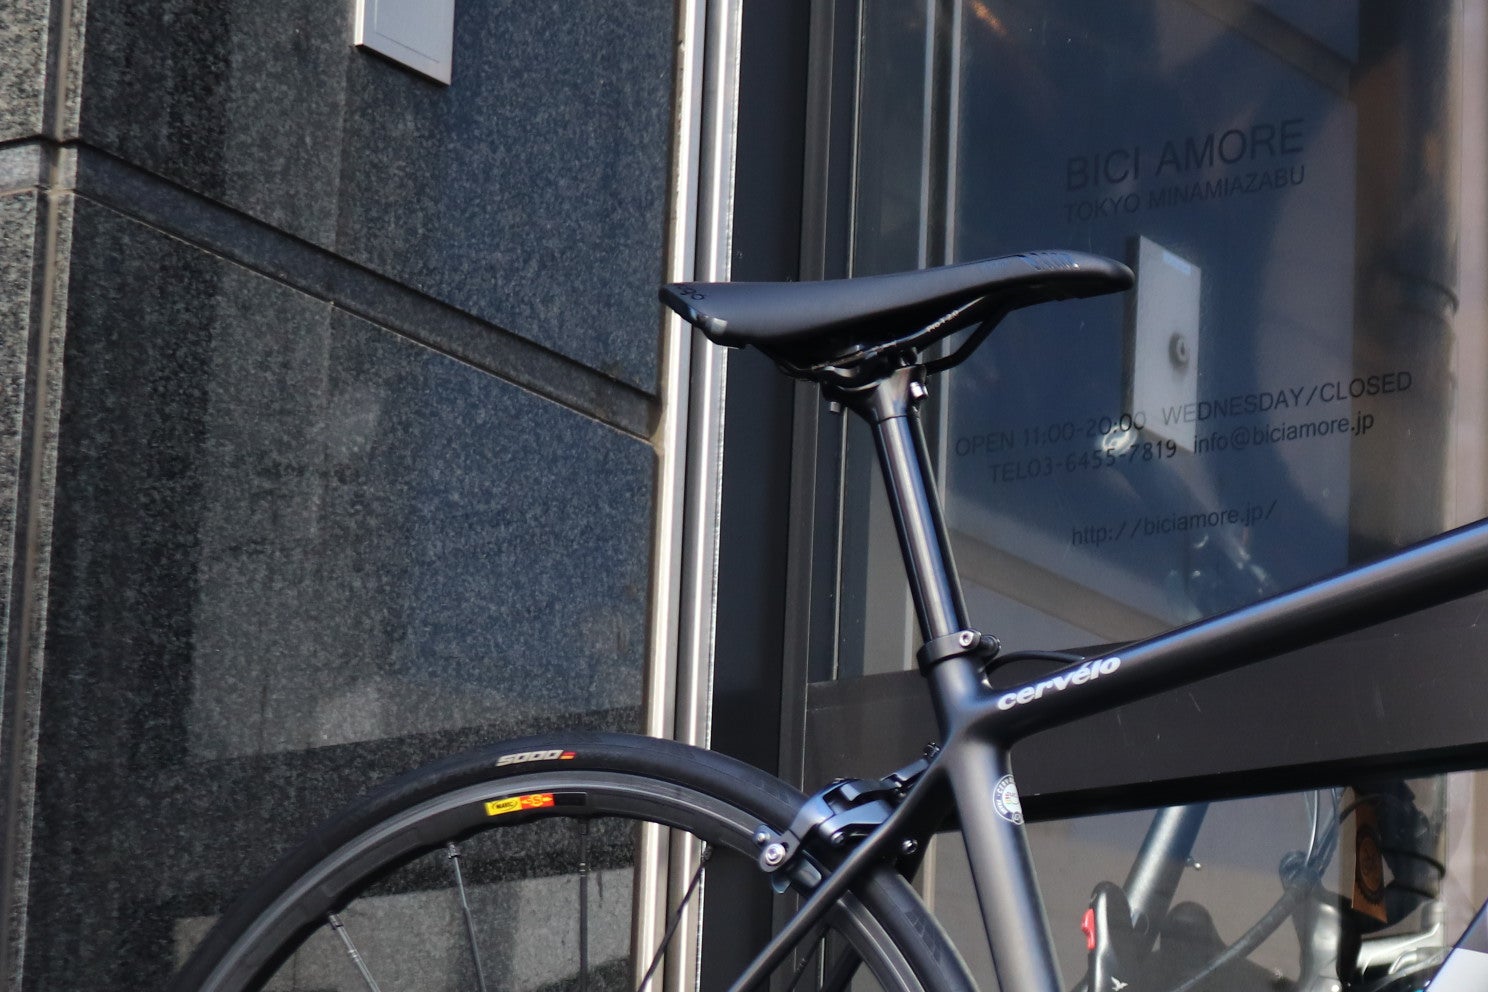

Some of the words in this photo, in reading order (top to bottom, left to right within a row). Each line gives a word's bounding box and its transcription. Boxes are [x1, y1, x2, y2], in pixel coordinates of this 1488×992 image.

[1066, 146, 1141, 192] BICI
[1155, 118, 1305, 177] AMORE
[1065, 193, 1141, 223] TOKYO
[1149, 165, 1305, 209] MINAMIAZABU
[955, 431, 1015, 457] OPEN
[1023, 411, 1147, 447] 11:00-20:00
[1161, 370, 1413, 426] WEDNESDAY/CLOSED
[1194, 410, 1375, 454] info@biciamore.jp
[1072, 499, 1278, 548] http://biciamore.jp/
[495, 749, 564, 767] 5000
